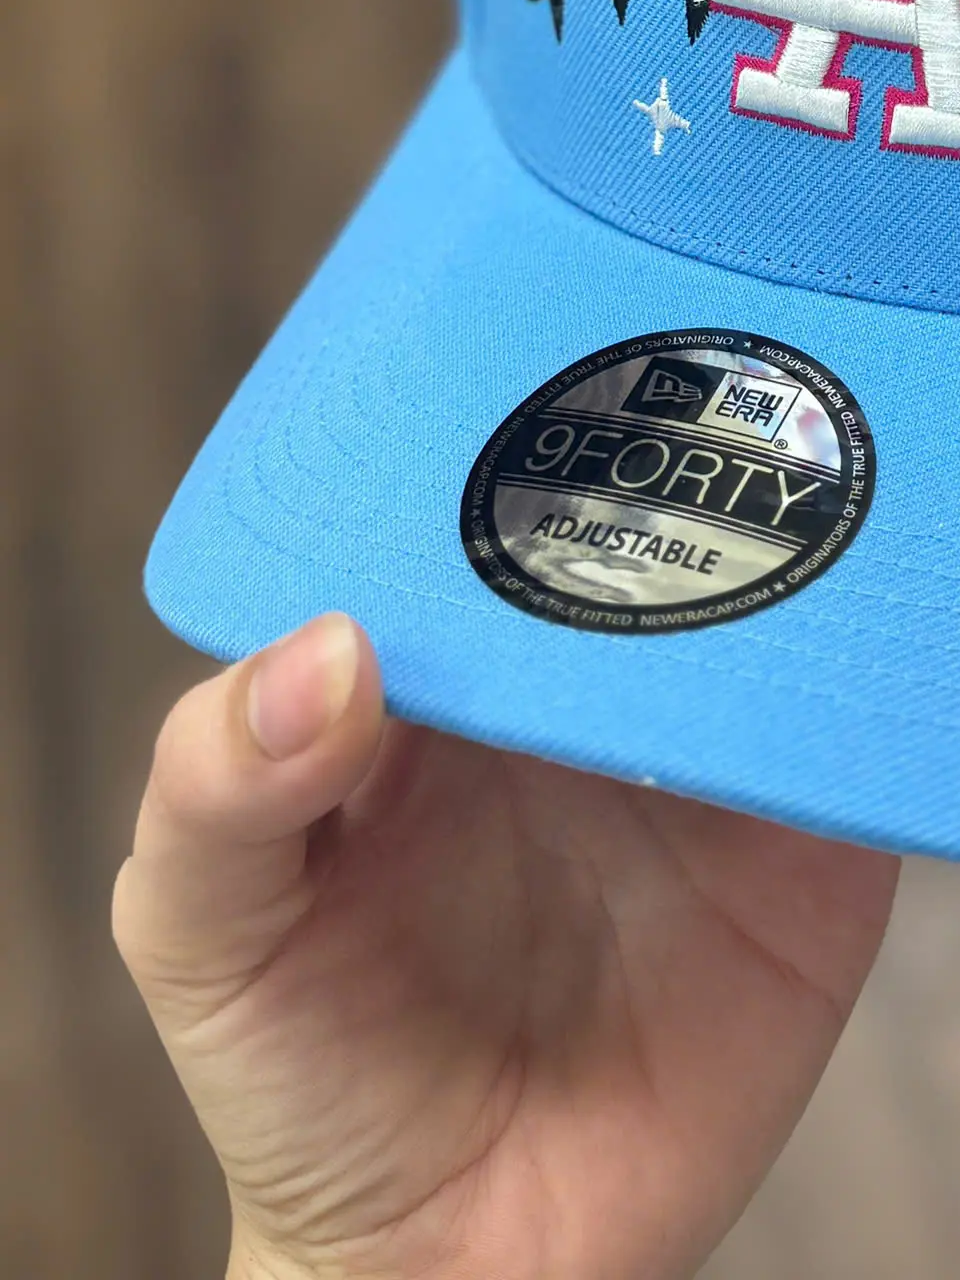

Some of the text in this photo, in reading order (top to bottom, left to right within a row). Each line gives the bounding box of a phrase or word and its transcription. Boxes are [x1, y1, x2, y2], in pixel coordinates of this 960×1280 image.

[626, 343, 642, 355] OF
[645, 334, 734, 350] ORIGINATORS
[597, 352, 623, 365] THE
[561, 362, 597, 385] TRUE
[524, 382, 562, 413] FITTED
[723, 384, 784, 411] NEW
[715, 401, 774, 427] ERA
[525, 424, 822, 526] 9FORTY
[759, 345, 866, 584] ORIGINATORS OF THE TRUE FITTED NEWERACAP.COM
[529, 513, 722, 575] ADJUSTABLE
[505, 578, 524, 592] OF
[522, 587, 547, 606] THE
[546, 597, 581, 619] TRUE
[580, 608, 633, 626] FITTED
[639, 588, 773, 626] NEWERACAP.COM
